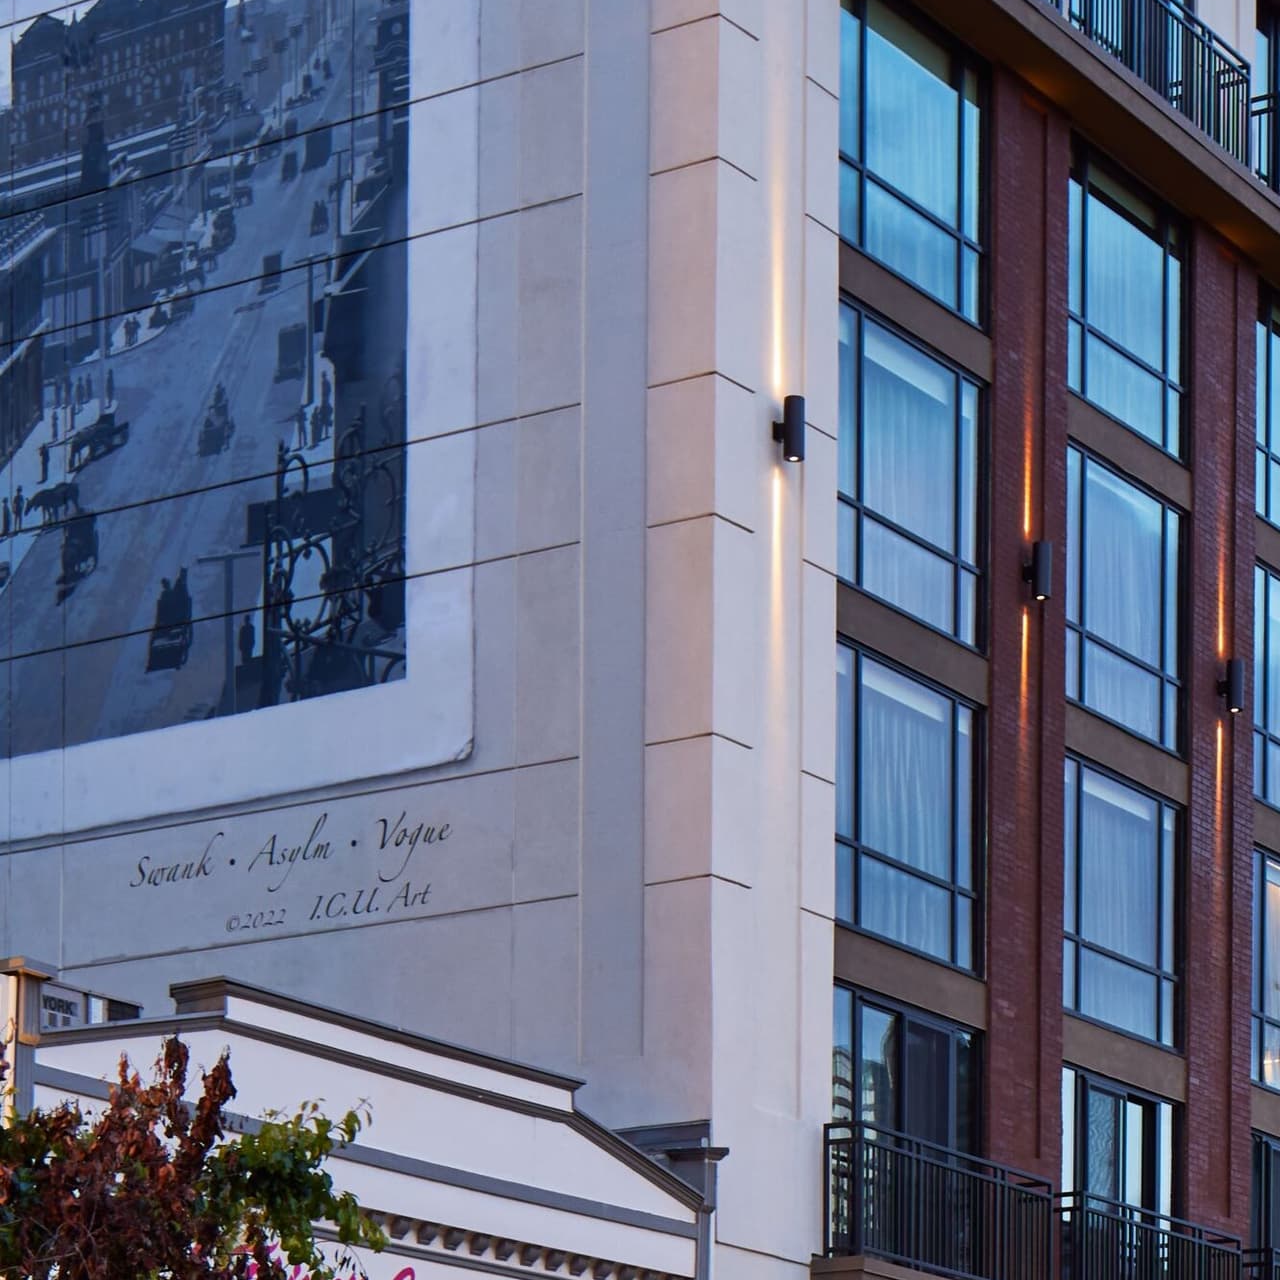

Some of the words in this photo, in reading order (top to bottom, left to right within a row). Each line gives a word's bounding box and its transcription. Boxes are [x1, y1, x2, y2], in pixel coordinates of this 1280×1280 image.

[129, 832, 224, 888] Swank
[248, 812, 332, 892] Asylm
[376, 810, 450, 882] Vogue
[225, 907, 287, 933] ©2022
[309, 887, 379, 920] I.C.U.
[386, 883, 431, 914] Art
[42, 994, 74, 1016] YORK
